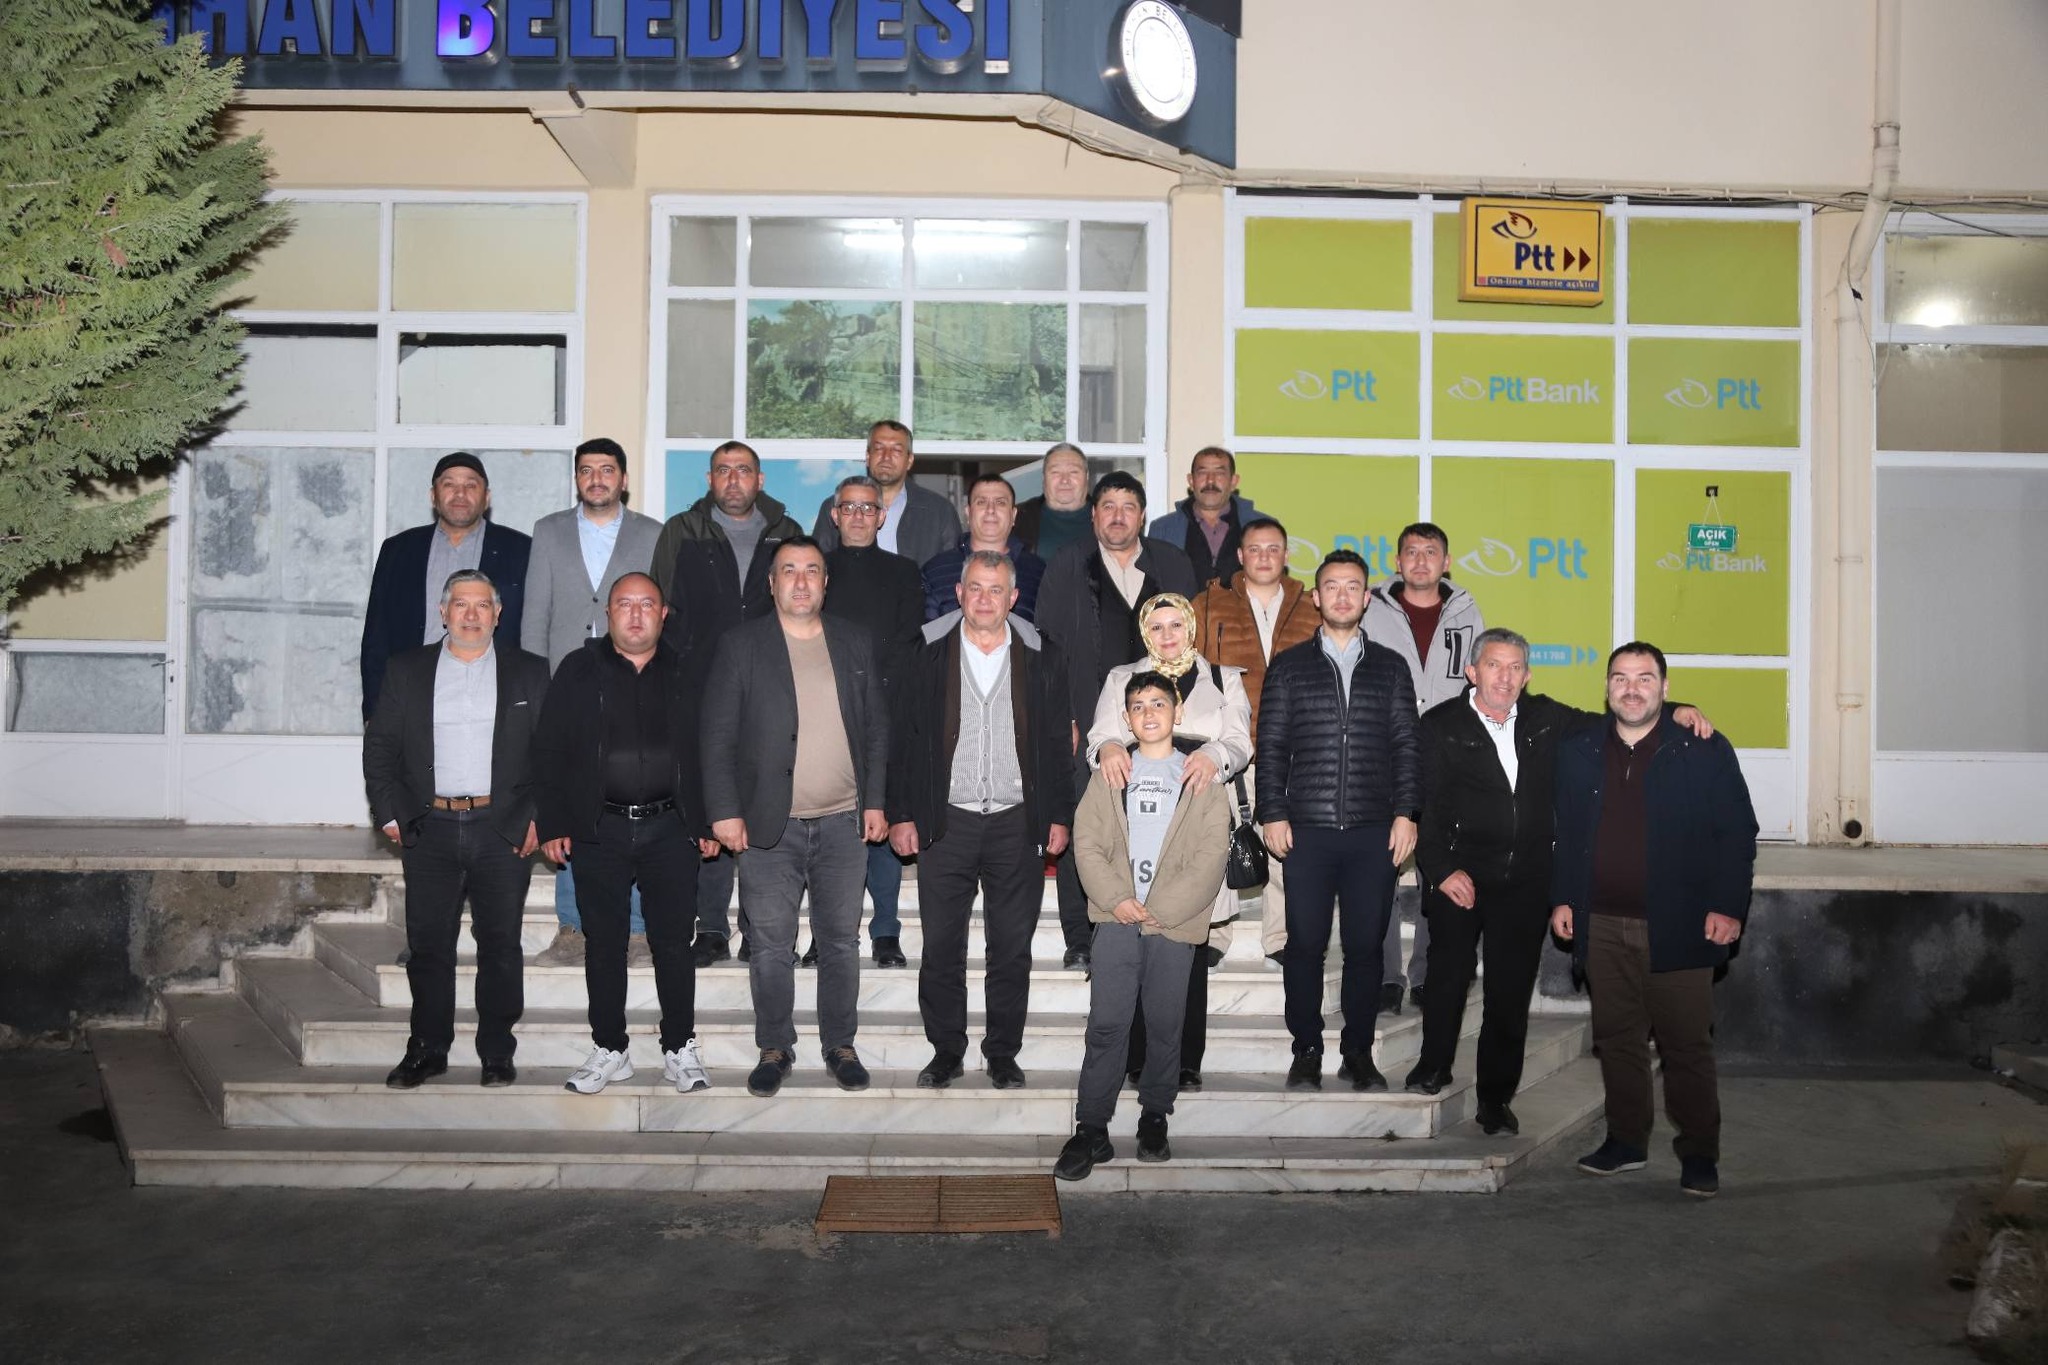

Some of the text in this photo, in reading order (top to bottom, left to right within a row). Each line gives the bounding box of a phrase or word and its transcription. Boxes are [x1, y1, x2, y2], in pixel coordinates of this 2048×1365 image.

[1514, 242, 1556, 271] Ptt
[1331, 369, 1377, 402] Ptt
[1489, 376, 1601, 405] PttBank
[1716, 378, 1762, 411] Ptt
[1697, 529, 1727, 540] AÇIK
[1528, 537, 1588, 580] Ptt
